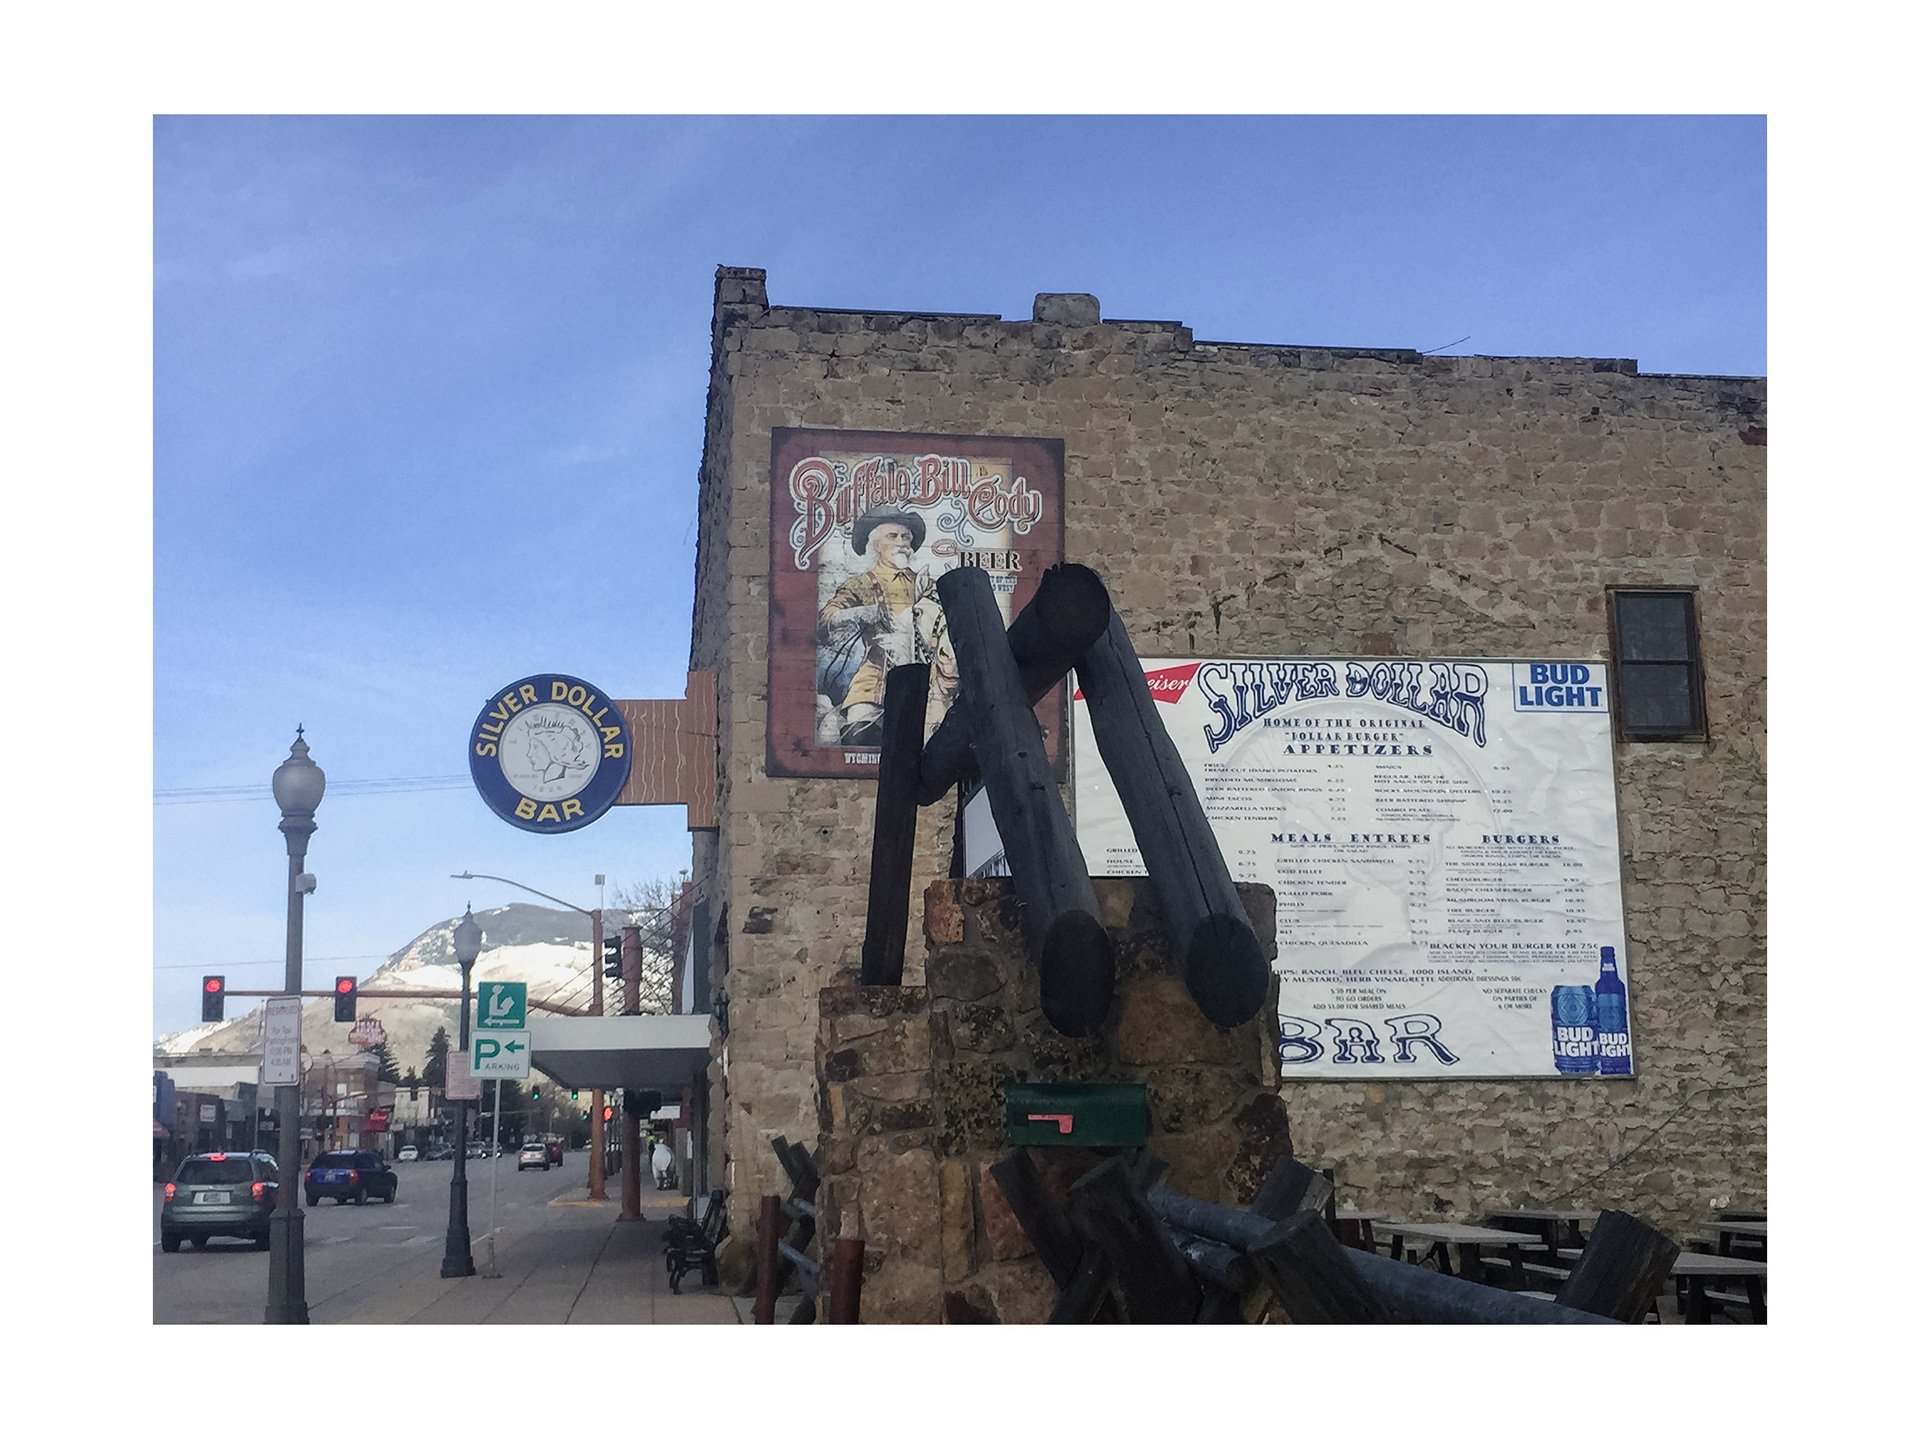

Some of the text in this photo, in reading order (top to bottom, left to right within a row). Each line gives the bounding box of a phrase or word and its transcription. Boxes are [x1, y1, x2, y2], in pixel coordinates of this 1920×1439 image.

[790, 455, 1042, 568] Buffalo Bill Cody
[958, 551, 1022, 571] BEER
[1530, 663, 1590, 685] BUD
[1147, 674, 1189, 691] eiser
[1519, 686, 1602, 707] LIGHT
[1197, 663, 1489, 754] SILVER DOLLAR
[475, 681, 624, 759] SILVER DOLLAR
[1262, 718, 1425, 728] HOME OF THE ORIGINAL
[1283, 744, 1433, 755] APPETIZERS
[514, 797, 585, 822] BAR
[1270, 833, 1432, 843] MEALS ENTREES
[1482, 834, 1560, 844] BURGERS
[1429, 942, 1476, 950] BLACKEN
[1479, 942, 1508, 950] YOUR
[1511, 942, 1552, 950] BURGER
[1556, 942, 1578, 950] FOR
[1278, 1014, 1460, 1066] BAR
[1557, 1027, 1594, 1041] BUD
[1599, 1033, 1627, 1045] BUD
[1554, 1041, 1600, 1057] LIGHT
[1600, 1045, 1630, 1057] IGHT
